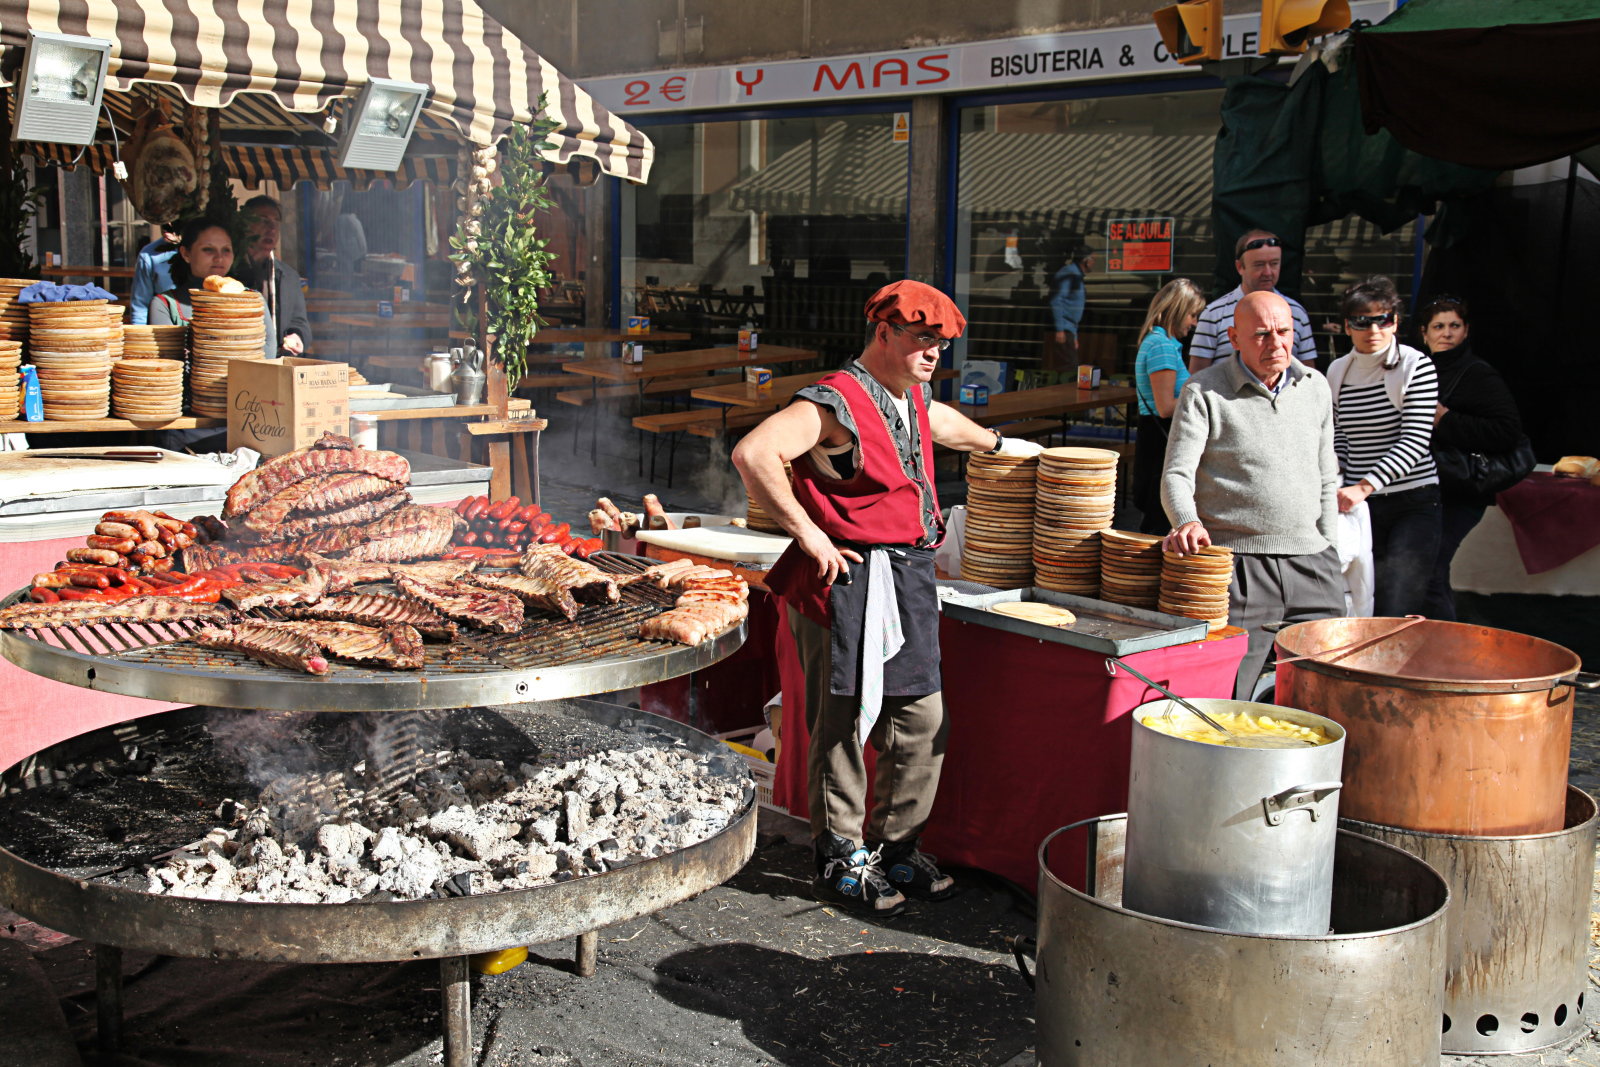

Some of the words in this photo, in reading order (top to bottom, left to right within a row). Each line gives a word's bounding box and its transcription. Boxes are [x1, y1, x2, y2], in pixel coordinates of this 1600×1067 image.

[736, 69, 764, 96] Y
[812, 54, 950, 92] MAS
[990, 47, 1104, 77] BISUTERIA
[1119, 44, 1135, 67] &
[1110, 223, 1124, 240] SE
[1125, 222, 1171, 240] ALQUILA
[235, 390, 261, 413] Coto
[241, 404, 286, 442] Redondo
